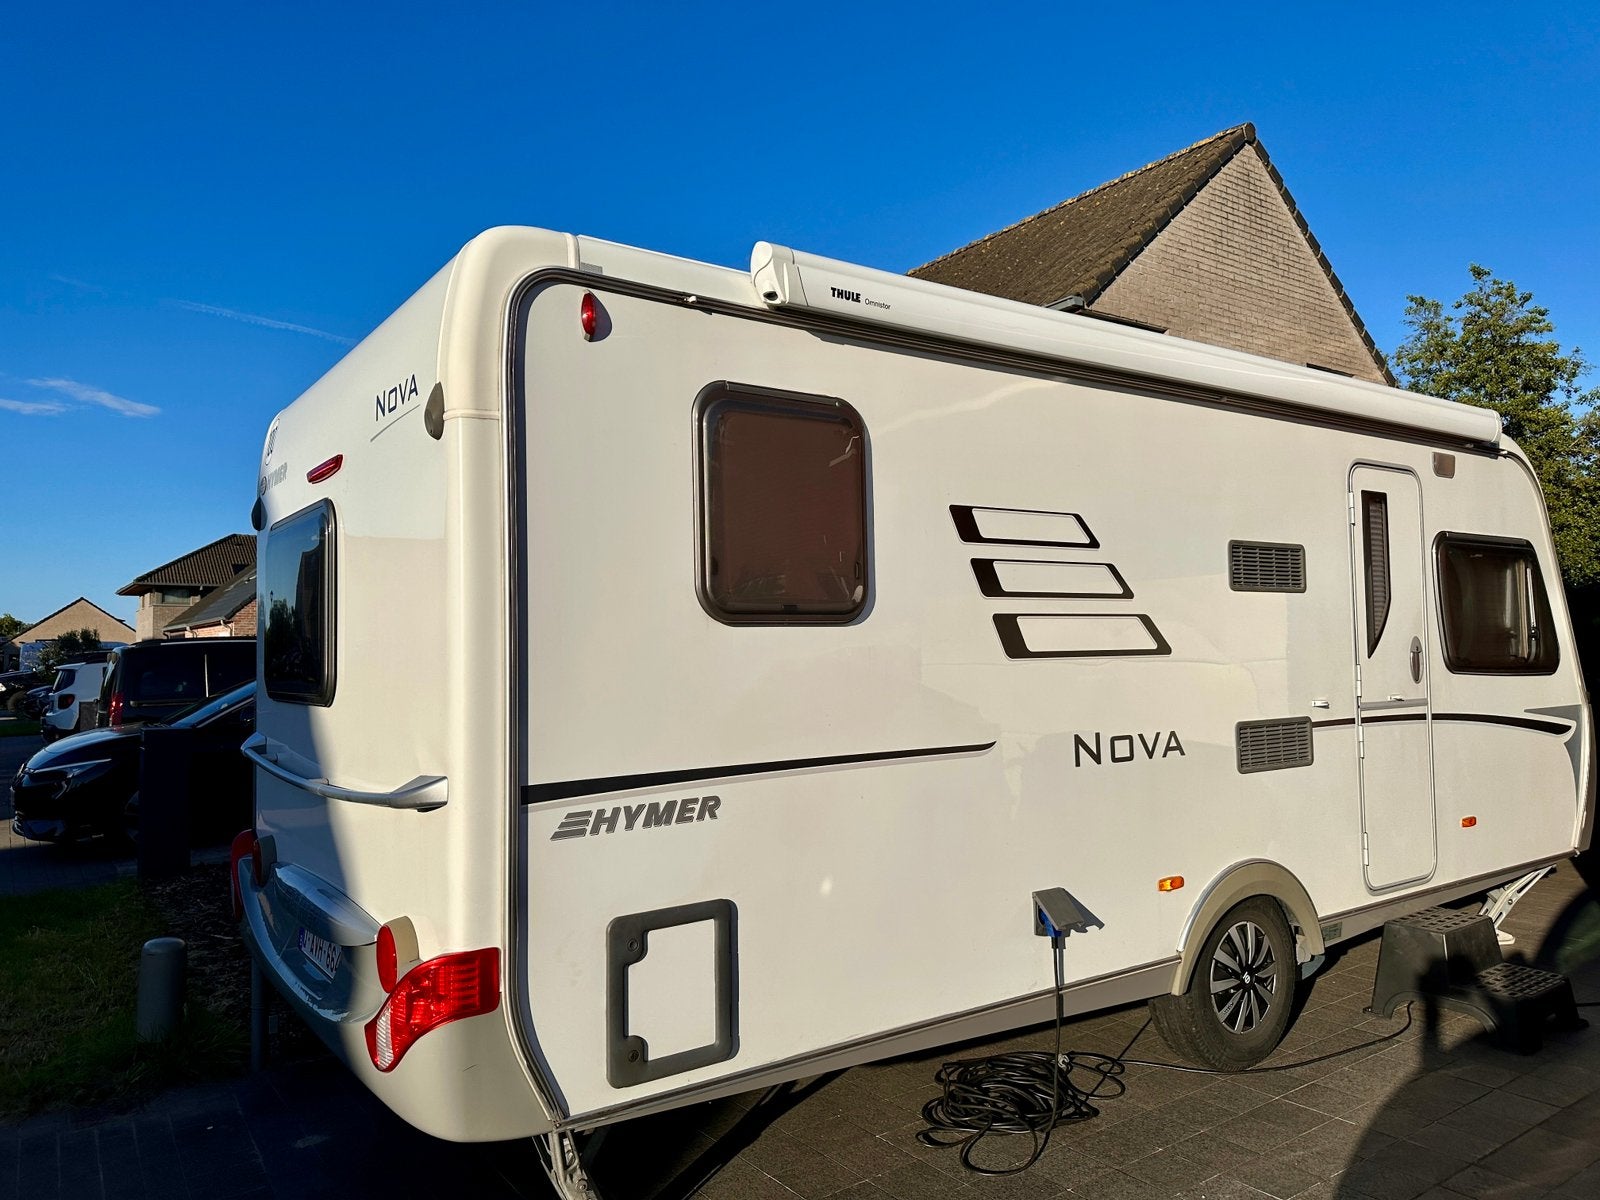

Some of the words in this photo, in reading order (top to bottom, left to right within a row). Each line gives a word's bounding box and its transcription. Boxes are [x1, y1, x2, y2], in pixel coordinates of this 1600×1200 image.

[831, 287, 861, 303] THULE
[865, 298, 891, 310] Omnistor
[375, 373, 418, 422] NOVA
[1073, 731, 1186, 767] NOVA
[589, 795, 722, 836] HYMER
